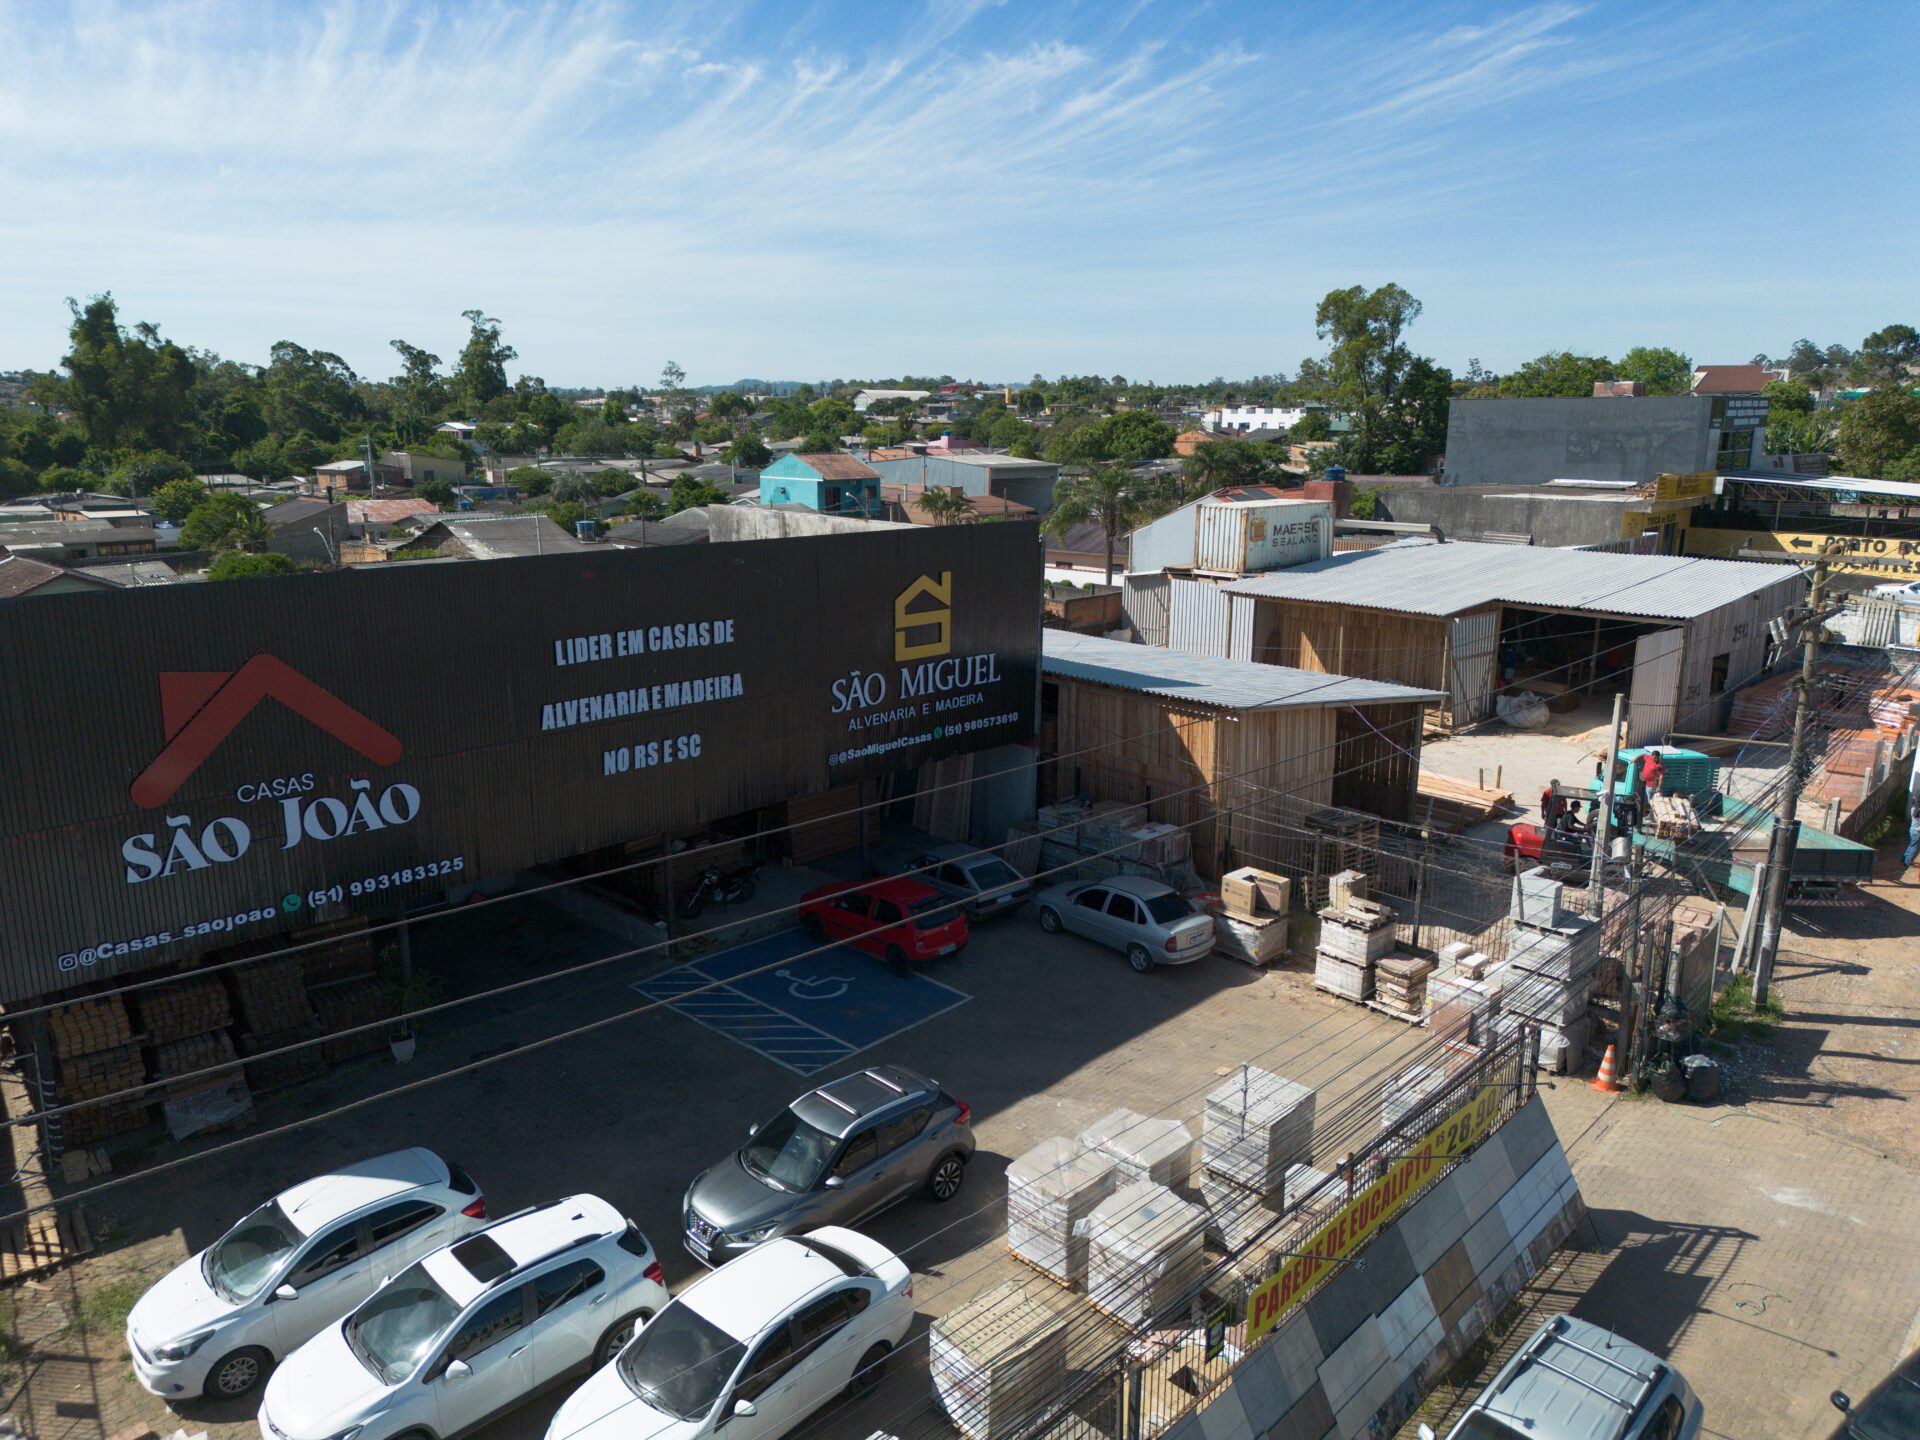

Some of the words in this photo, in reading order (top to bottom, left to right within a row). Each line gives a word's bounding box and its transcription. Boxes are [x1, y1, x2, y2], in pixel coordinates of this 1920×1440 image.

[1272, 534, 1318, 547] SEALAND
[1273, 522, 1318, 536] MAERSK
[555, 634, 613, 666] LIDER
[616, 629, 644, 657] EM
[648, 622, 710, 652] CASAS
[713, 619, 734, 645] DE
[541, 688, 650, 731] ALVENARIA
[652, 686, 662, 710] E
[664, 672, 744, 708] MADEIRA
[831, 671, 886, 713] SÃO
[900, 653, 1001, 699] MIGUEL
[848, 706, 916, 731] ALVENARIA
[922, 703, 930, 715] E
[935, 692, 984, 712] MADEIRA
[945, 723, 963, 738] (51)
[603, 747, 630, 776] NO
[634, 741, 659, 769] RS
[663, 739, 673, 763] E
[677, 733, 701, 760] SC
[236, 773, 315, 803] CASAS
[121, 814, 251, 884] SÃO
[280, 779, 421, 849] JOÃO
[79, 905, 276, 966] @Casas_saojoao
[308, 885, 344, 909] (51)
[350, 856, 465, 897] 993183325
[1253, 1238, 1323, 1329] PAREDE
[1326, 1216, 1347, 1263] DE
[1350, 1143, 1432, 1241] EUCALIPTO
